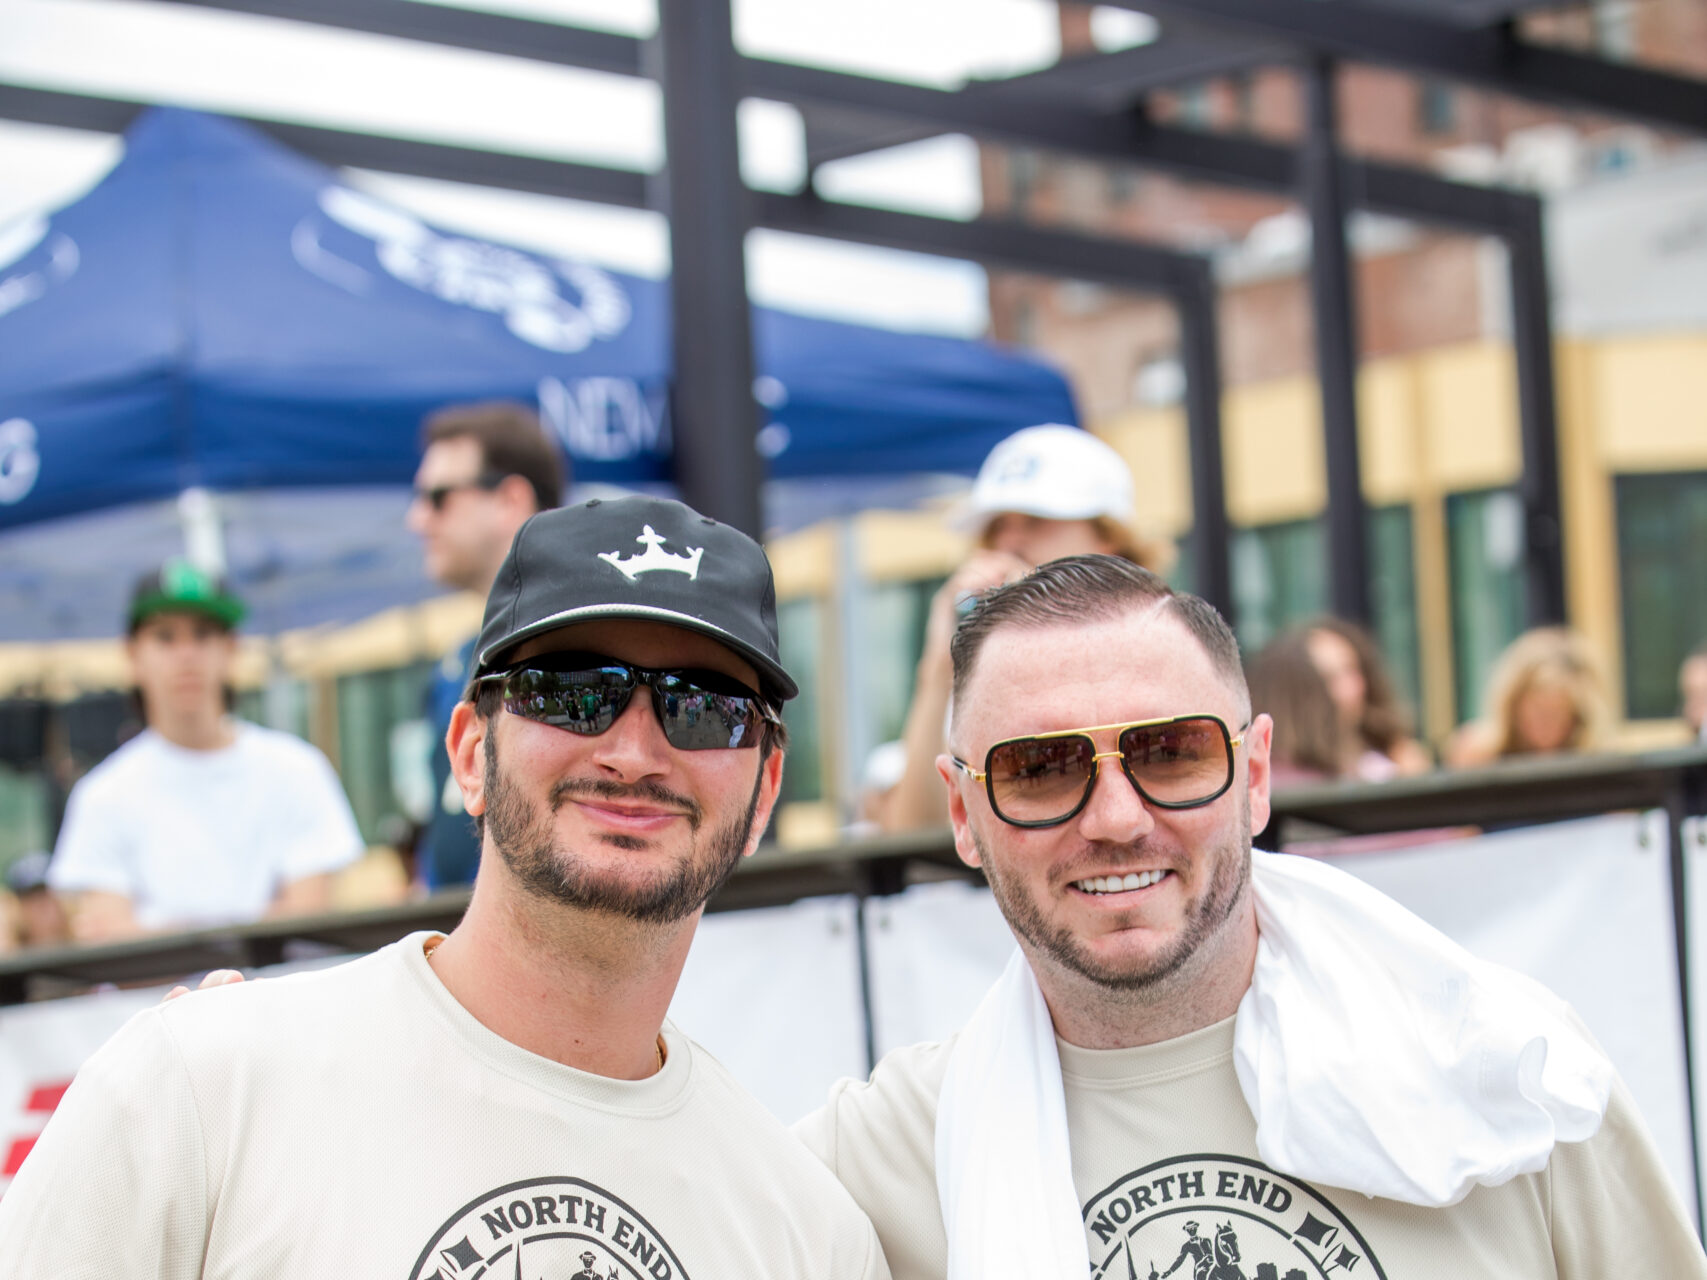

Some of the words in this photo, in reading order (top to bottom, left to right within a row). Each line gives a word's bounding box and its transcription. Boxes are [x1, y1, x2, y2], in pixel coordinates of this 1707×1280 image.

[481, 1194, 606, 1241] NORTH
[1090, 1170, 1205, 1245] NORTH
[1215, 1170, 1292, 1214] END
